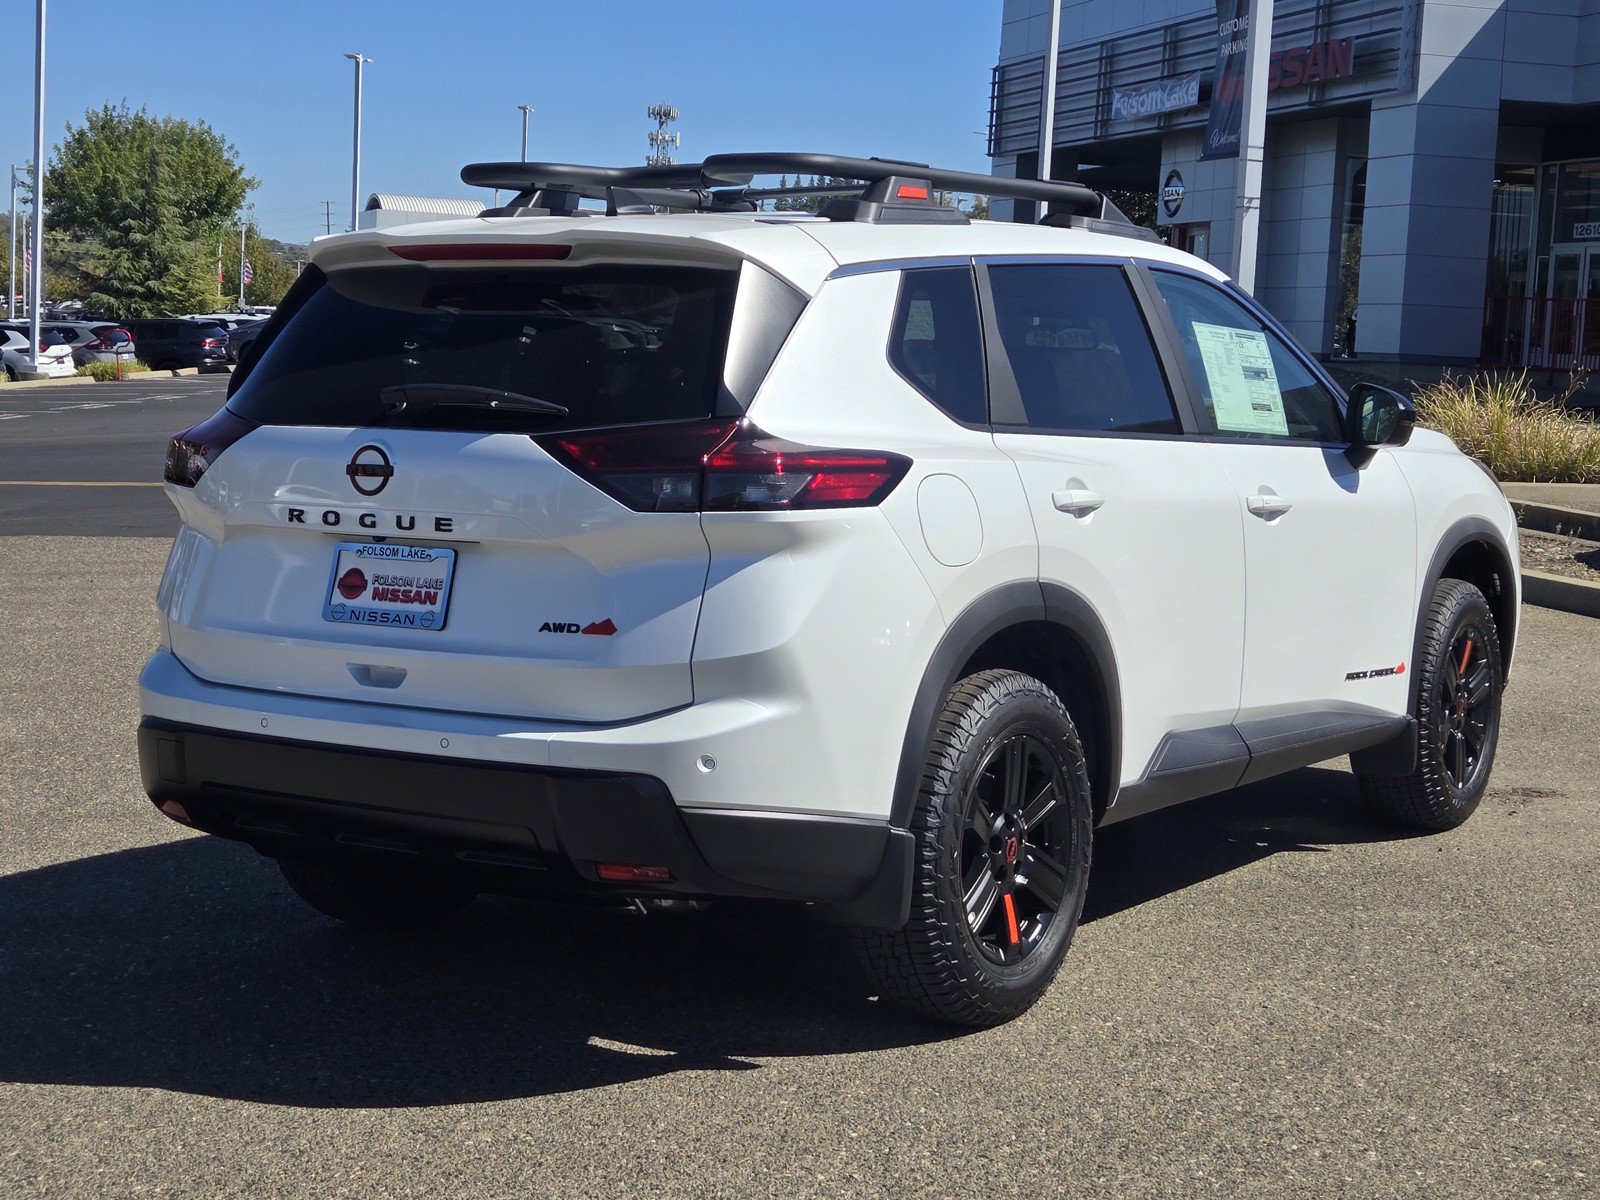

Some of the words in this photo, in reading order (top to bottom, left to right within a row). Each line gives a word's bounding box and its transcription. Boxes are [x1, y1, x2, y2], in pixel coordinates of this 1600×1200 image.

[1219, 15, 1249, 36] CUSTOME
[288, 508, 454, 533] ROGUE
[362, 545, 399, 557] FOLSOM
[401, 548, 427, 559] LAKE
[372, 574, 414, 588] FOLSOM
[416, 578, 444, 590] LAKE
[372, 586, 438, 606] NISSAN
[349, 609, 415, 626] NISSAN
[538, 621, 581, 634] AWD
